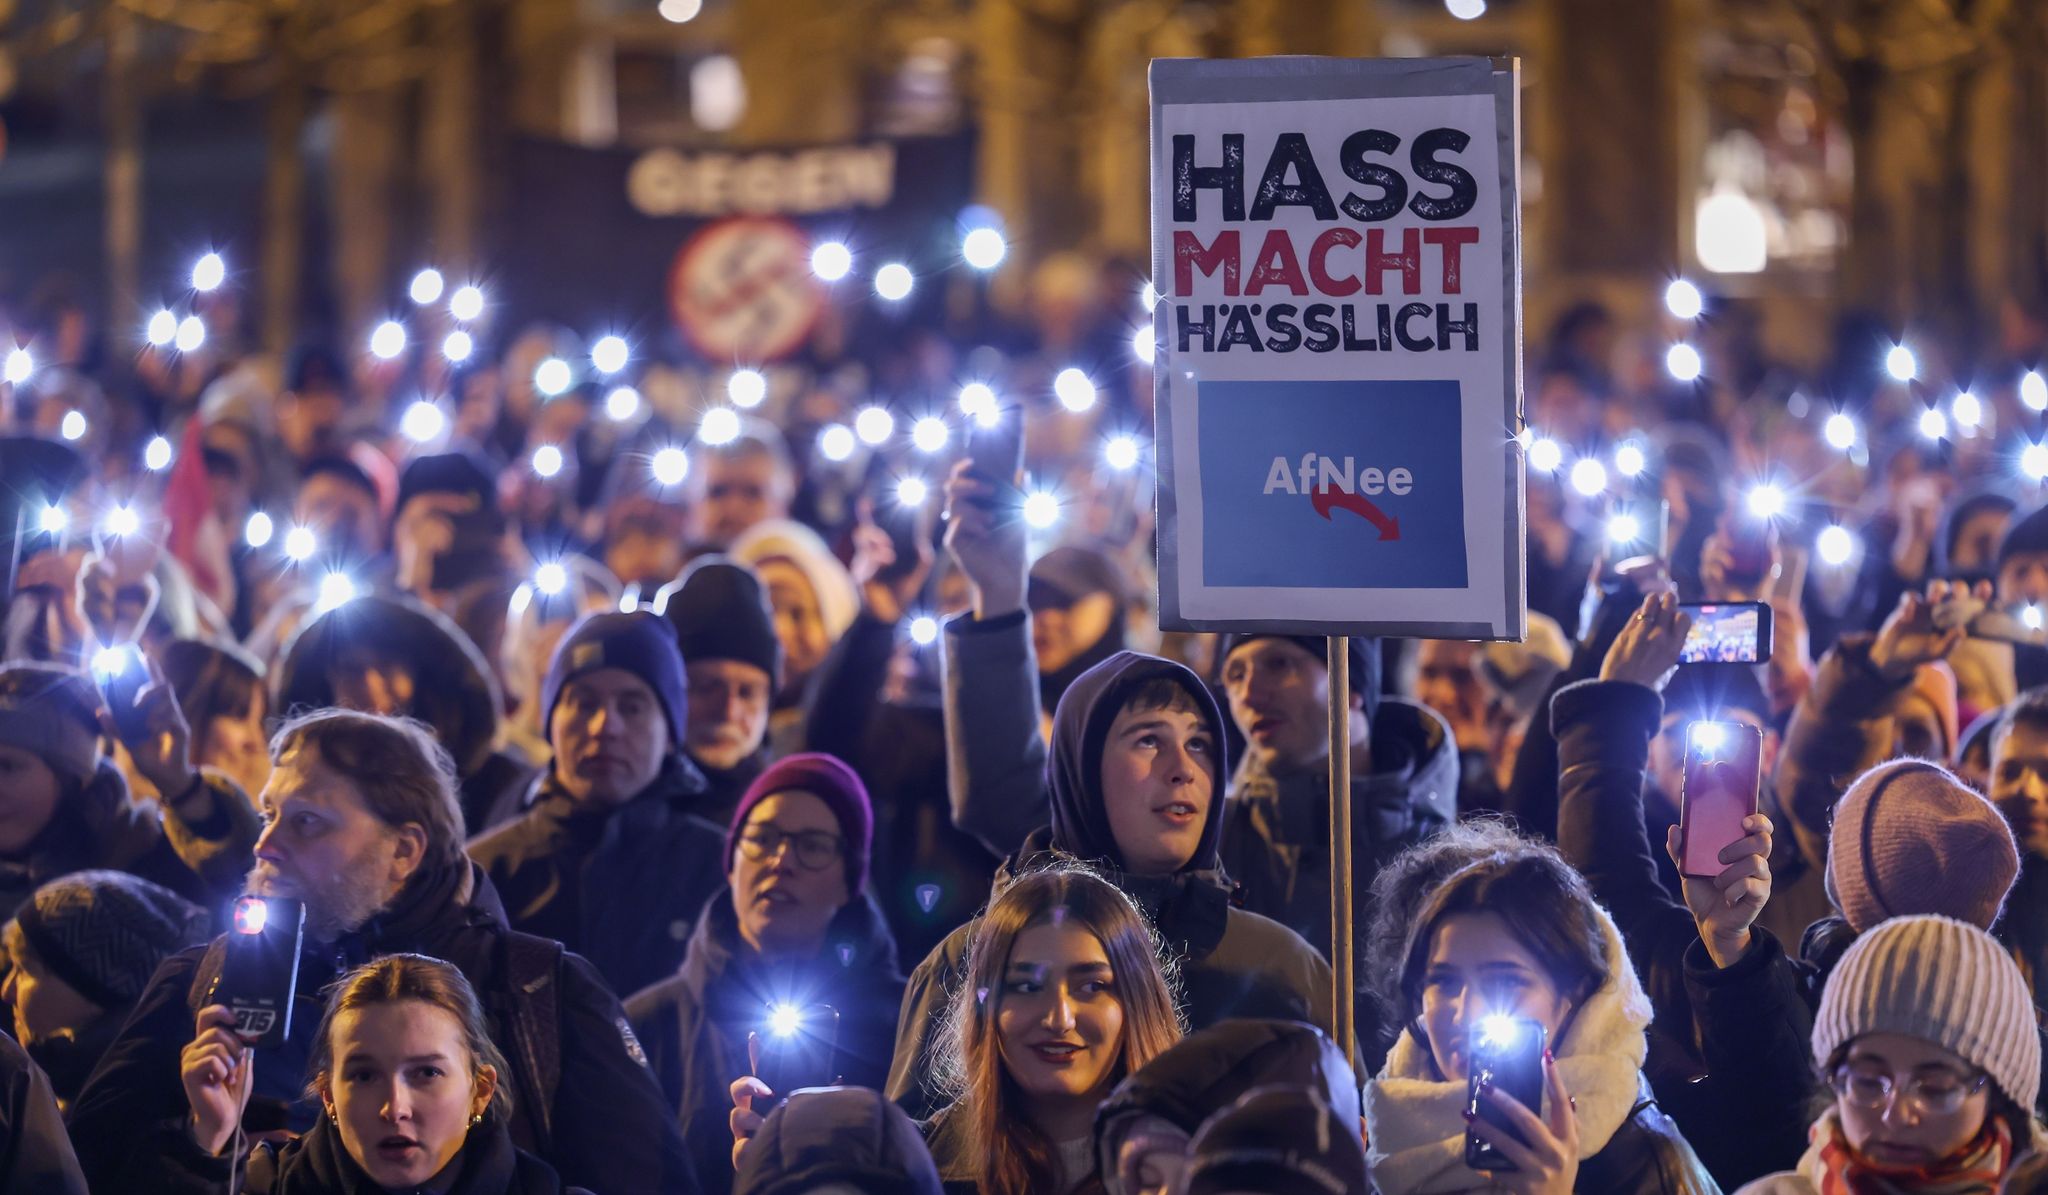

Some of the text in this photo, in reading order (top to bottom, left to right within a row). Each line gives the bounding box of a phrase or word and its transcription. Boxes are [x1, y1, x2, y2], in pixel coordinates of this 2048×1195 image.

[629, 147, 895, 216] GEGEN
[1172, 127, 1478, 222] HASS
[1173, 227, 1479, 296] MACHT
[1176, 302, 1479, 353] HÄSSLICH
[1263, 452, 1413, 496] AfNee
